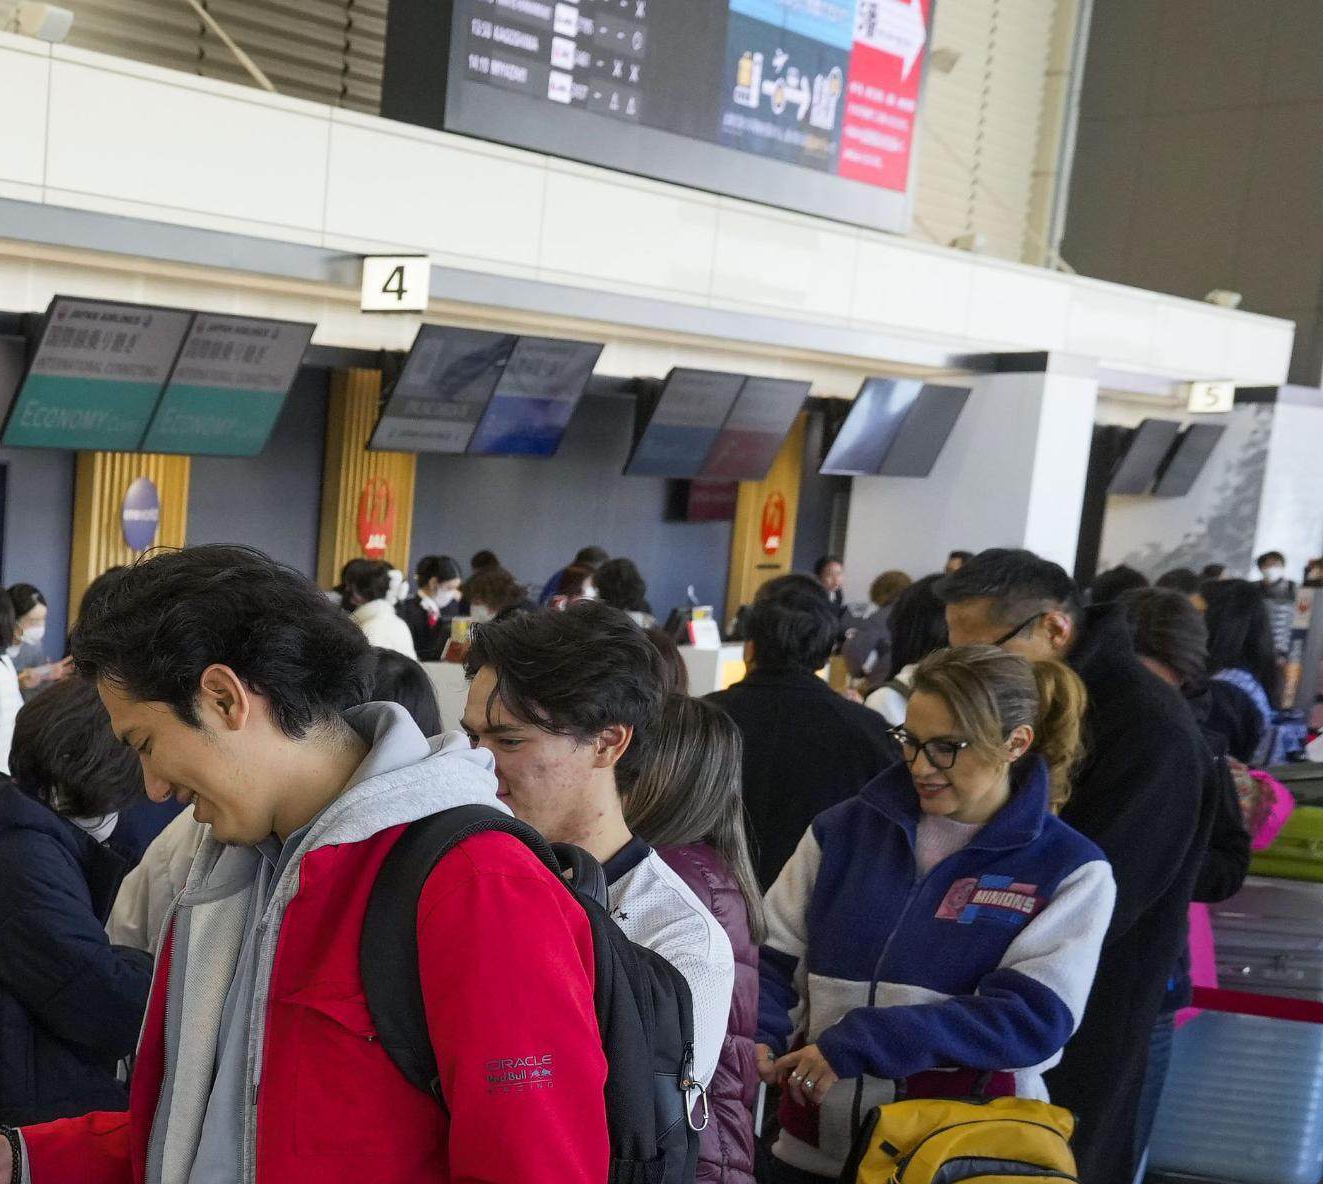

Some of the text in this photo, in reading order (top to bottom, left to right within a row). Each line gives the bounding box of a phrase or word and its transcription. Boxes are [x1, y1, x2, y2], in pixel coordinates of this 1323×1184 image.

[381, 265, 408, 301] 4
[1206, 386, 1221, 404] 5
[971, 889, 1036, 914] MINIONS
[485, 1054, 553, 1071] ORACLE
[508, 1070, 527, 1081] Bull
